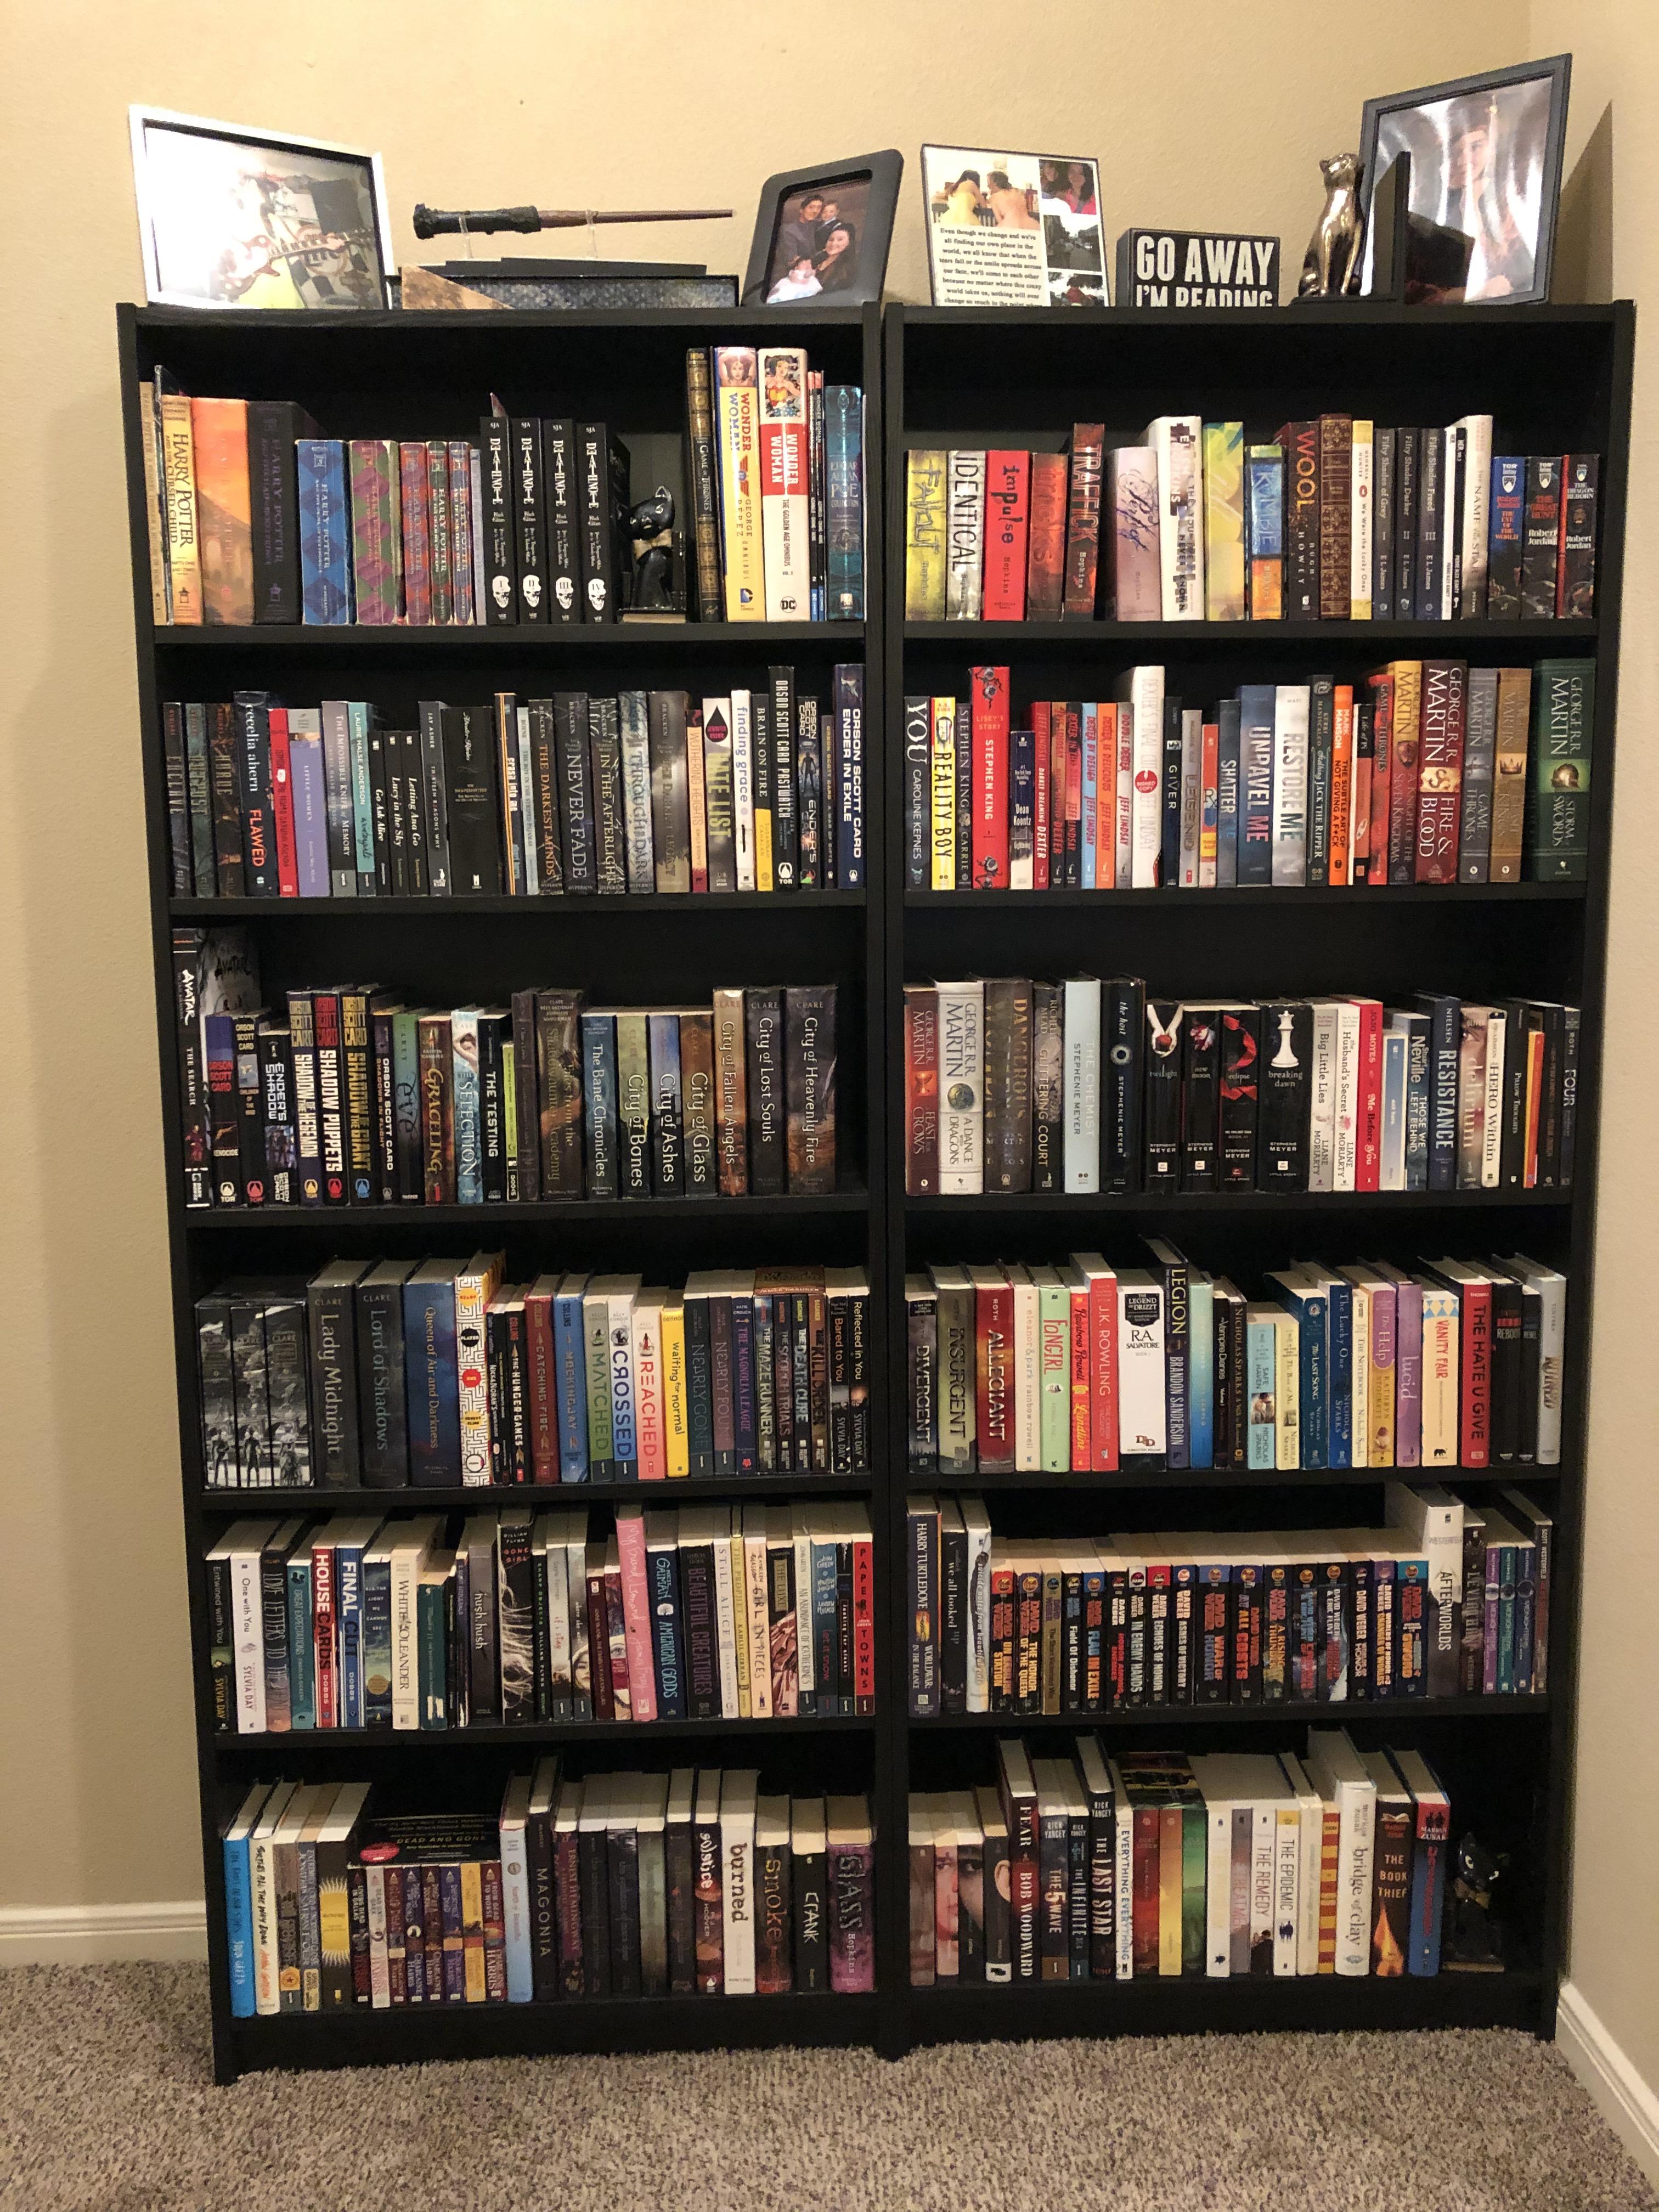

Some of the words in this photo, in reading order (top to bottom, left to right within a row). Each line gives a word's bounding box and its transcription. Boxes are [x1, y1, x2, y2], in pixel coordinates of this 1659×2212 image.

[1137, 236, 1175, 281] GO
[1184, 239, 1274, 285] AWAY
[741, 392, 752, 452] WONDER
[173, 433, 190, 486] HARRY
[771, 436, 782, 483] WOMAN
[786, 433, 798, 484] WONDER
[1380, 436, 1389, 454] Fifty
[167, 465, 176, 506] CURSED
[1070, 443, 1101, 543] TRAFFICK
[1296, 430, 1316, 512] WOOL
[1380, 458, 1389, 486] Shades
[170, 509, 178, 543] CHILD
[176, 489, 193, 548] POTTER
[951, 457, 979, 572] IDENTICAL
[991, 465, 1023, 543] impulse
[1380, 498, 1388, 518] Grey
[1077, 552, 1086, 589] Hopkins
[1425, 668, 1448, 761] MARTIN
[1448, 668, 1462, 731] GEORGE
[246, 704, 261, 750] cecelia
[736, 707, 748, 756] finding
[757, 708, 765, 745] BRAIN
[843, 708, 851, 758] ENDER
[907, 701, 927, 765] YOU
[247, 754, 259, 792] ahern
[706, 752, 731, 796] HATE
[759, 749, 766, 766] ON
[843, 763, 851, 778] IN
[985, 740, 994, 790] STEPHEN
[1247, 726, 1271, 810] UNRAVEL
[567, 754, 584, 822] NEVER
[736, 762, 749, 803] grace
[759, 770, 767, 797] FIRE
[778, 768, 791, 818] PASTWATCH
[912, 770, 921, 819] CAROLINE
[934, 752, 952, 820] REALITY
[1220, 760, 1235, 814] SHATTER
[708, 802, 731, 838] LIST
[985, 793, 994, 820] KING
[1419, 798, 1437, 857] BLOOD
[1439, 797, 1455, 833] FIRE
[249, 810, 265, 866] FLAWED
[913, 822, 921, 859] KEPNES
[935, 827, 952, 857] BOY
[1246, 816, 1268, 842] ME
[1437, 837, 1453, 856] &
[571, 827, 586, 878] FADE
[183, 969, 195, 1025] AVATAR
[802, 1017, 817, 1047] City
[1318, 1033, 1329, 1050] Big
[319, 1049, 338, 1109] SHADOW
[804, 1051, 816, 1063] of
[1319, 1053, 1329, 1080] Little
[1411, 1036, 1426, 1083] Neville
[275, 1063, 286, 1121] ENDER'S
[487, 1071, 496, 1098] THE
[687, 1072, 708, 1111] City
[802, 1066, 818, 1132] Heavenly
[1318, 1083, 1328, 1103] Lies
[1435, 1050, 1456, 1149] RESISTANCE
[1564, 1069, 1576, 1107] FOUR
[323, 1114, 342, 1171] PUPPETS
[425, 1068, 443, 1175] GRACELING
[458, 1081, 477, 1178] SELECTION
[488, 1102, 498, 1157] TESTING
[692, 1116, 707, 1130] of
[693, 1134, 708, 1182] Glass
[805, 1137, 819, 1163] Fire
[1099, 1305, 1109, 1326] J.K.
[1171, 1269, 1186, 1334] LEGION
[1473, 1305, 1487, 1335] THE
[317, 1314, 340, 1361] Lady
[854, 1301, 862, 1347] Reflected
[1076, 1308, 1089, 1347] Rainbow
[669, 1342, 680, 1381] waiting
[855, 1350, 863, 1359] in
[855, 1362, 864, 1380] You
[1076, 1350, 1087, 1380] Rowell
[1099, 1330, 1110, 1396] ROWLING
[1169, 1356, 1184, 1395] BRANDON
[1472, 1341, 1486, 1382] HATE
[512, 1372, 522, 1413] HUNGER
[592, 1353, 609, 1451] MATCHED
[916, 1345, 930, 1443] DIVERGENT
[988, 1329, 1005, 1441] ALLEGIANT
[1471, 1386, 1484, 1396] U
[321, 1367, 344, 1453] Midnight
[515, 1415, 523, 1446] GAMES
[641, 1362, 657, 1457] REACHED
[672, 1396, 684, 1435] normal
[1074, 1403, 1087, 1451] Landline
[1170, 1397, 1185, 1446] SANDERSON
[1471, 1402, 1485, 1440] GIVE
[917, 1523, 927, 1551] HARRY
[317, 1554, 330, 1612] HOUSE
[342, 1561, 357, 1616] FINAL
[399, 1581, 409, 1618] WHITE
[917, 1554, 928, 1609] TURTLEDOVE
[948, 1578, 958, 1591] all
[948, 1594, 958, 1627] looked
[1438, 1571, 1452, 1650] AFTERWORLDS
[318, 1612, 331, 1669] CARDS
[345, 1621, 357, 1657] CUT
[398, 1629, 410, 1690] OLEANDER
[659, 1622, 675, 1666] AMERICAN
[1070, 1646, 1077, 1655] Of
[661, 1668, 678, 1698] GODS
[1019, 1806, 1031, 1846] FEAR
[1092, 1858, 1111, 1893] LAST
[1121, 1830, 1130, 1893] EVERYTHING
[1256, 1846, 1271, 1867] THE
[1351, 1848, 1368, 1895] bridge
[1380, 1871, 1407, 1881] BOOK
[1384, 1855, 1404, 1864] THE
[730, 1843, 748, 1923] burned
[764, 1859, 787, 1942] smoke
[1020, 1872, 1032, 1899] BOB
[1255, 1871, 1270, 1917] REMEDY
[1379, 1888, 1407, 1898] THIEF
[537, 1868, 550, 1956] MAGONIA
[1092, 1900, 1111, 1935] STAR
[1351, 1900, 1363, 1912] of
[1020, 1903, 1033, 1976] WOODWARD
[1345, 1914, 1365, 1945] clay
[848, 1933, 856, 1973] Hopkins
